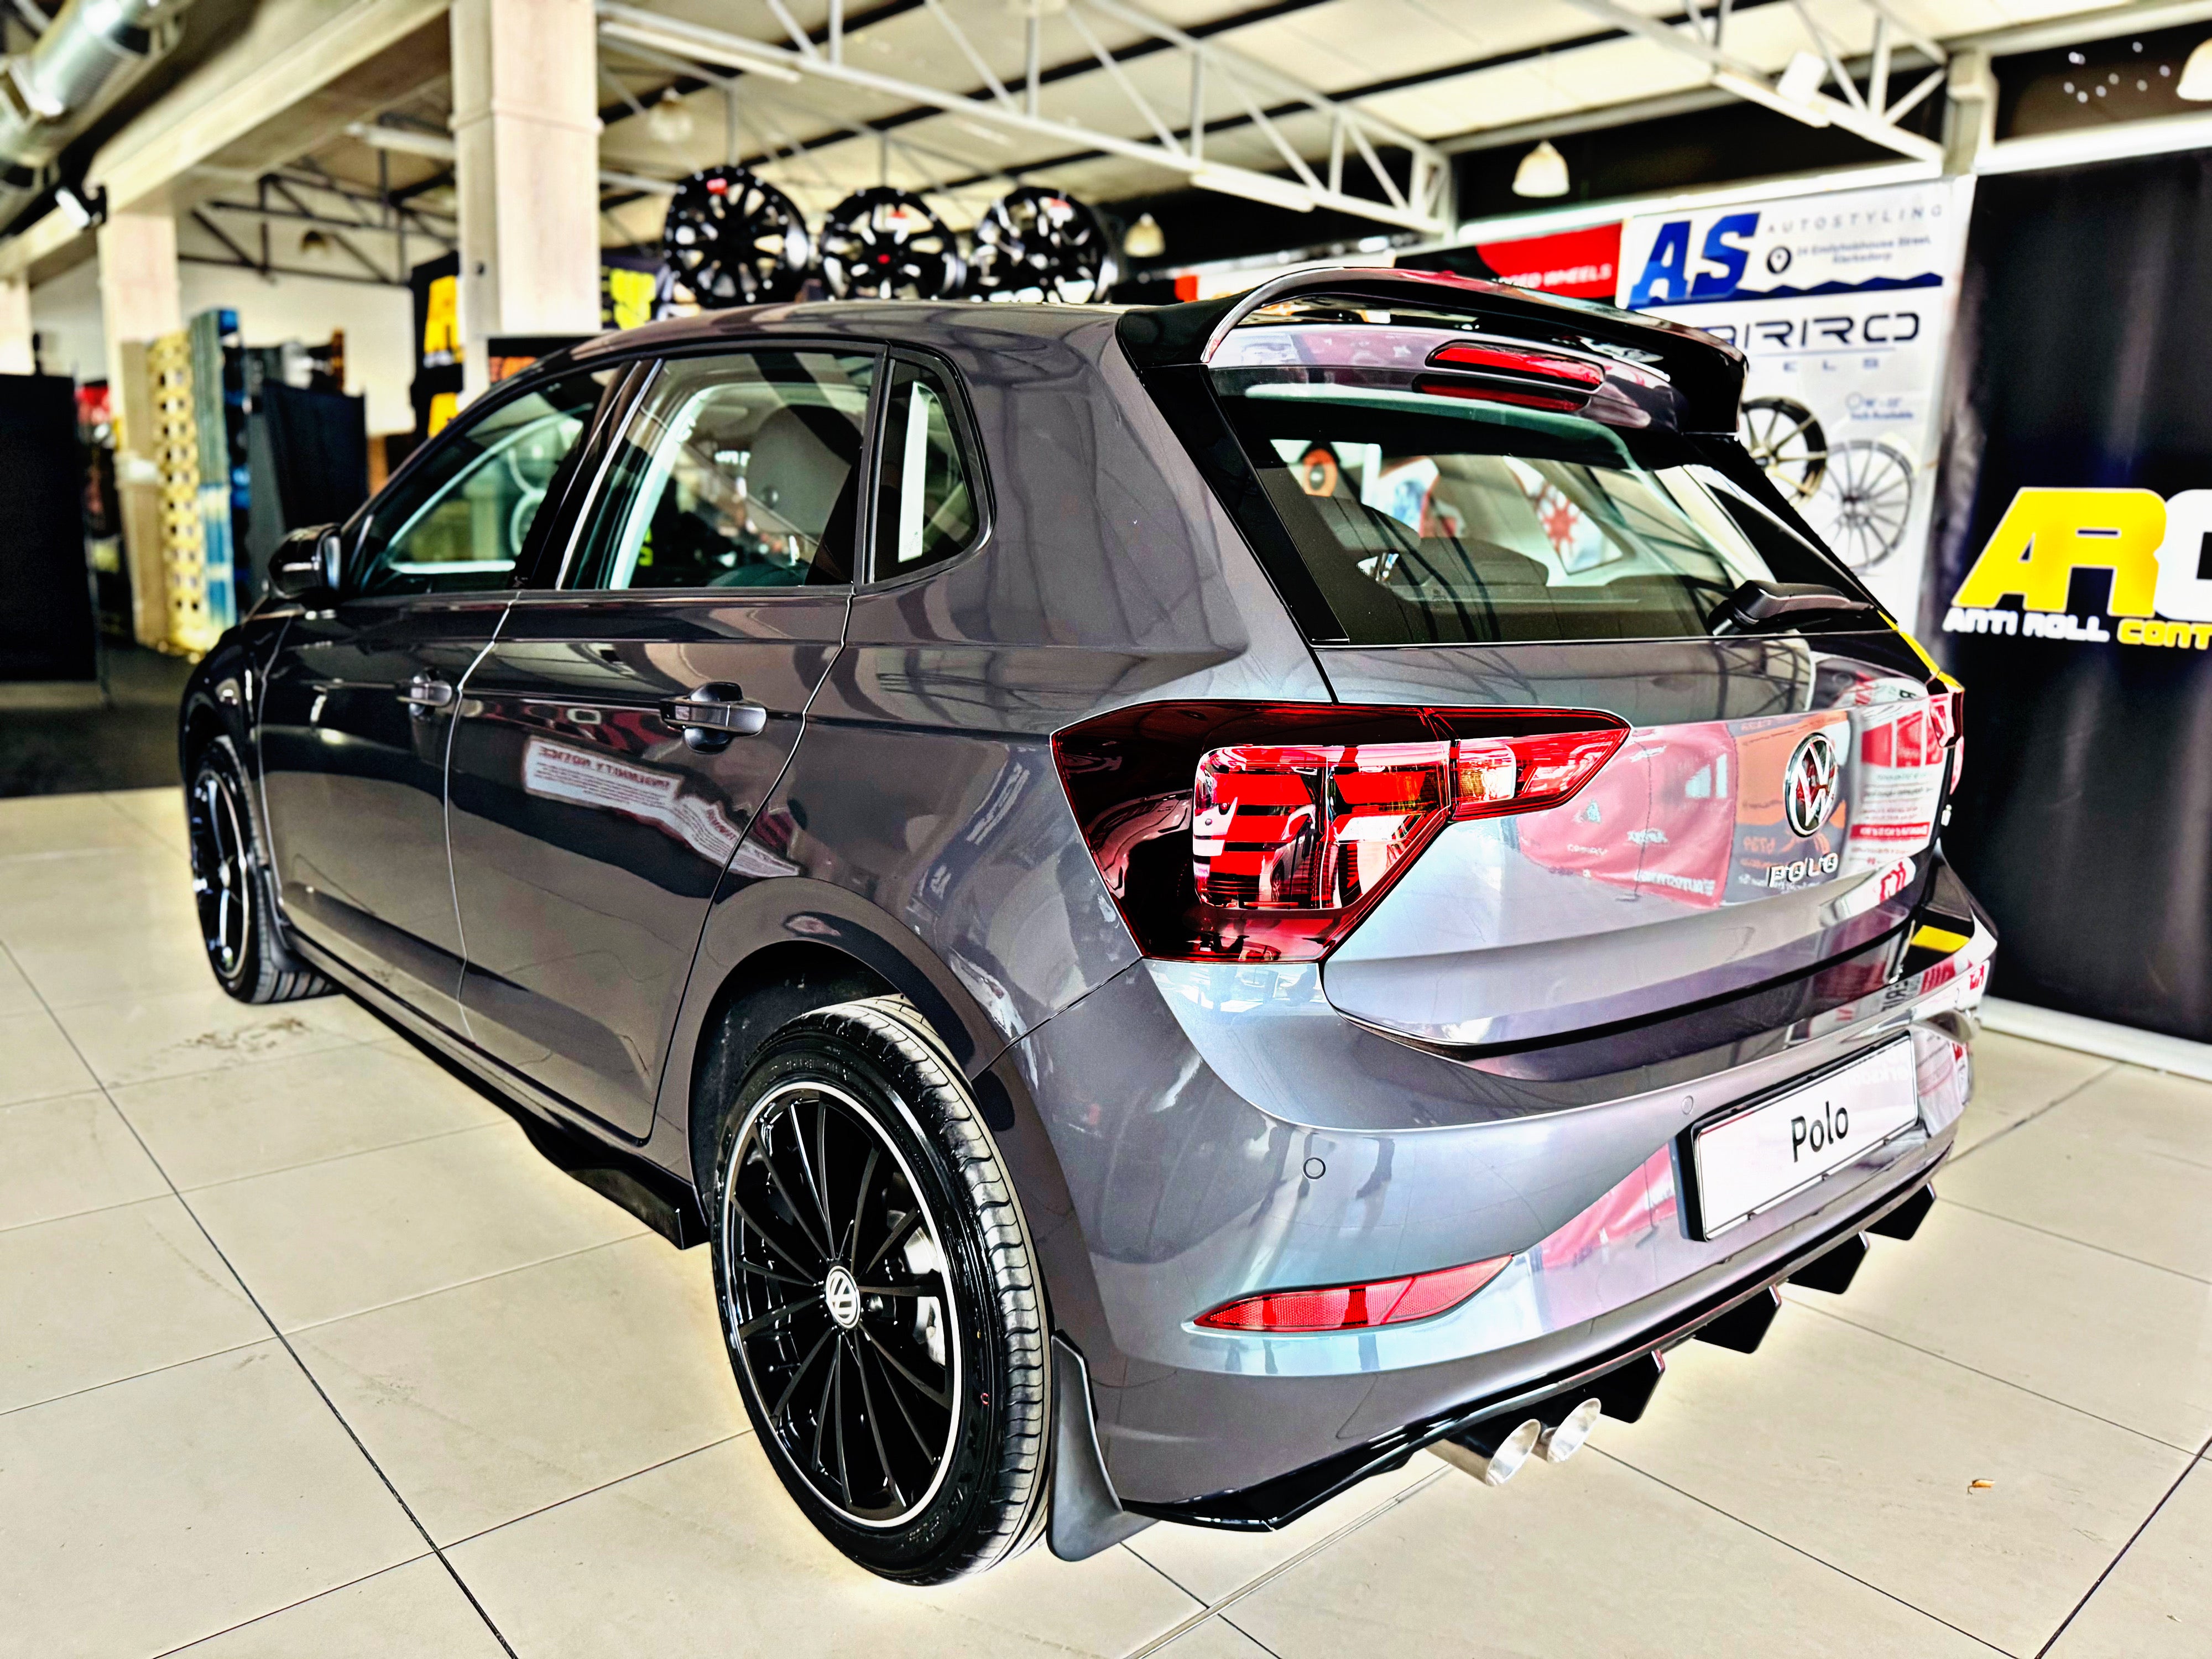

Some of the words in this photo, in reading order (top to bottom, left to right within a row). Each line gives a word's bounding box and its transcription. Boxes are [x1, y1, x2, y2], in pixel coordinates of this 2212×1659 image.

[1768, 205, 1942, 233] AUTOSTYLING
[1629, 212, 1761, 300] AS
[2022, 612, 2110, 643] ROLL
[1767, 852, 1839, 888] POLO
[1790, 1100, 1849, 1162] Polo
